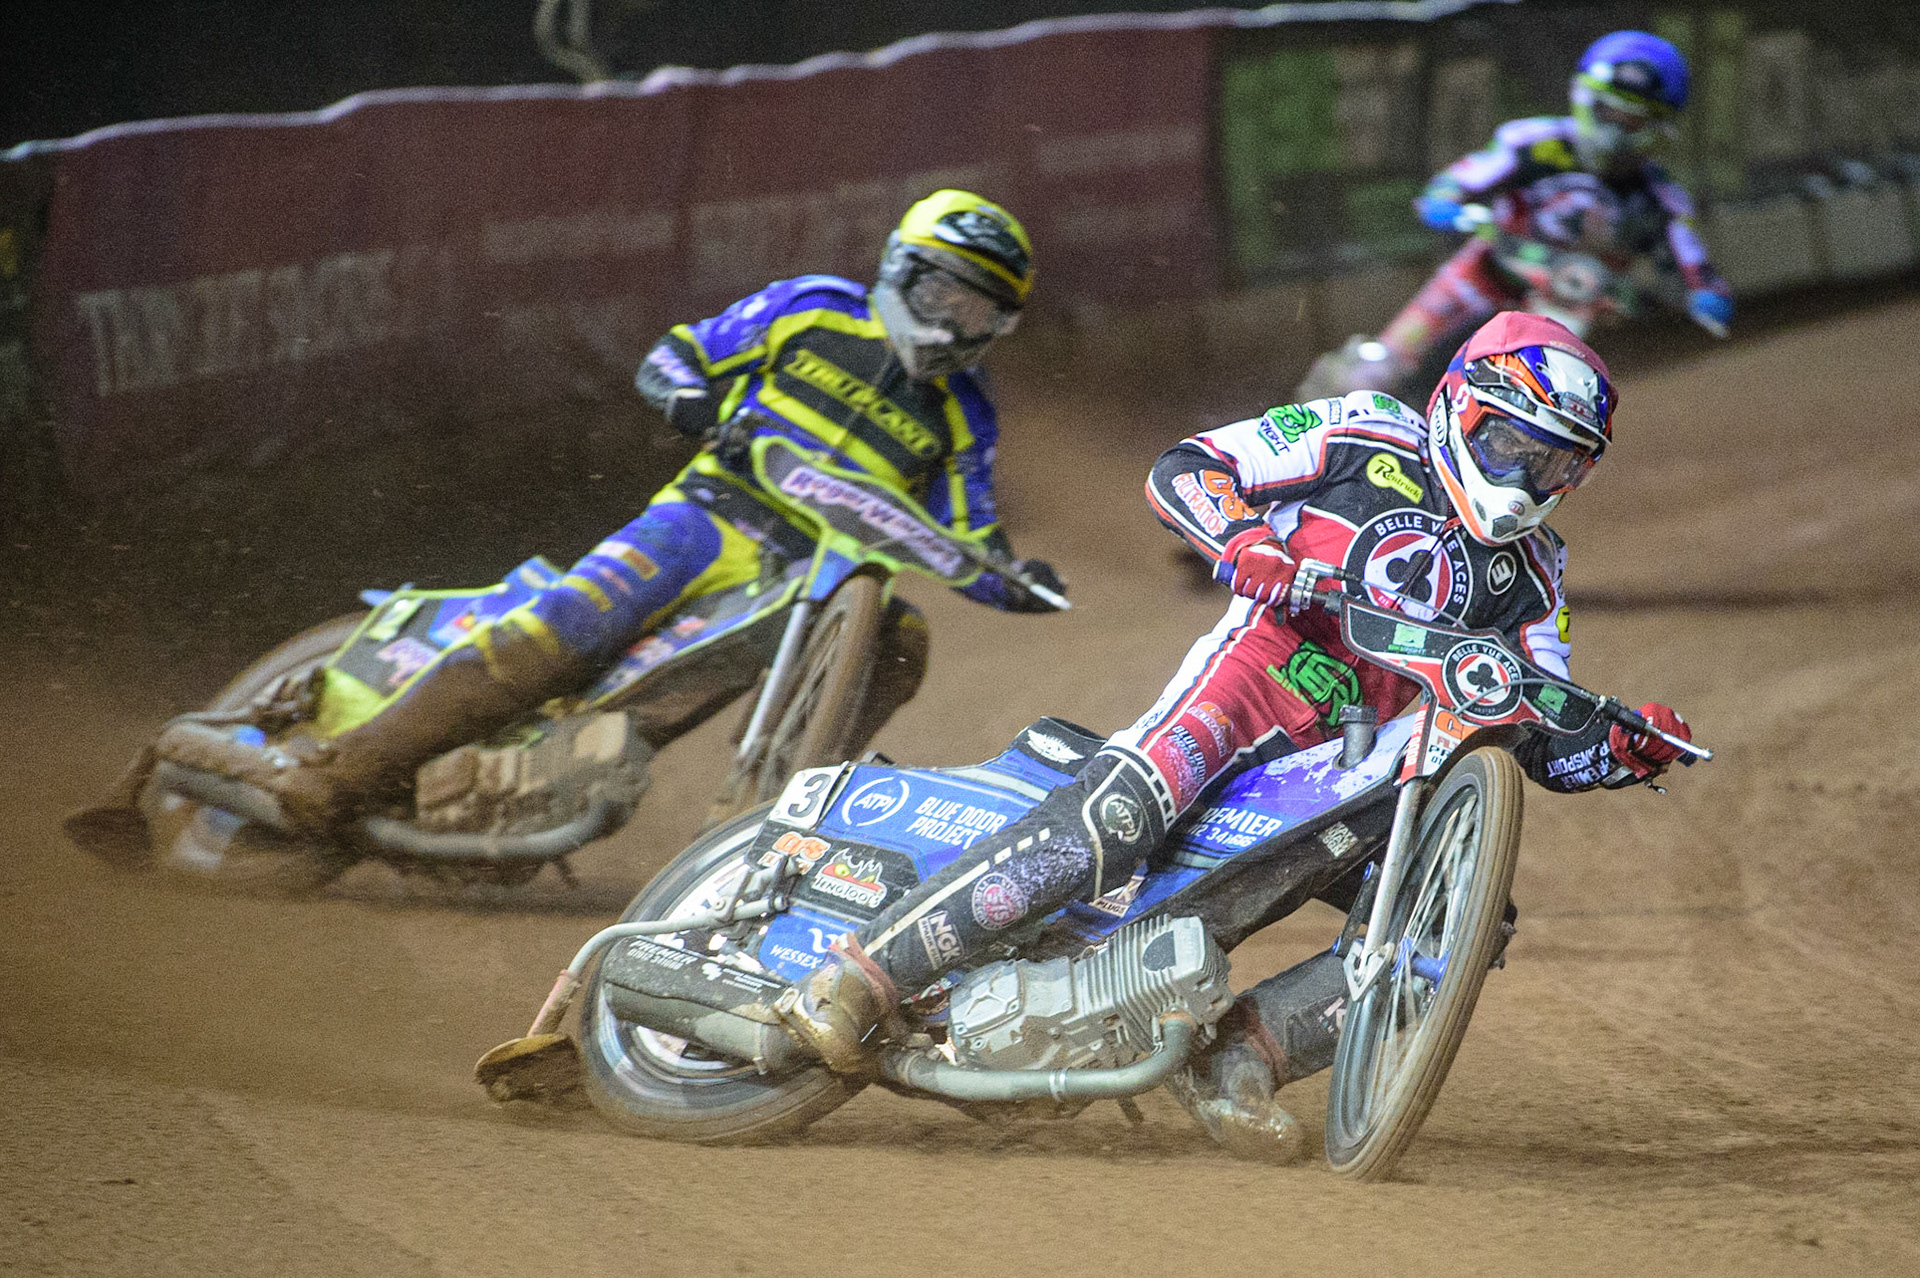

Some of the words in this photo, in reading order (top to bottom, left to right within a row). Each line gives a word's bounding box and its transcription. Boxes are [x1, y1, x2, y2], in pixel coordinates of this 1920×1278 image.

[1374, 459, 1420, 499] Rentruck
[1174, 473, 1229, 536] FILTRATION
[1374, 516, 1423, 537] BELLE
[1431, 521, 1460, 553] VE
[1453, 559, 1470, 605] ACES
[1451, 645, 1479, 662] BELLE
[1482, 645, 1502, 661] VUE
[1502, 660, 1520, 682] ACE
[1171, 725, 1200, 755] BLUE
[788, 773, 831, 818] 3
[854, 792, 896, 812] ATPI
[905, 818, 983, 850] PROJECT
[915, 797, 961, 818] BLUE
[953, 803, 1008, 836] DOOR
[1110, 801, 1135, 836] ATPI
[1200, 807, 1283, 837] REMIER
[920, 918, 937, 948] SPARK
[930, 912, 964, 962] NGK
[628, 939, 698, 964] PREMIER
[769, 944, 823, 969] WESSEX
